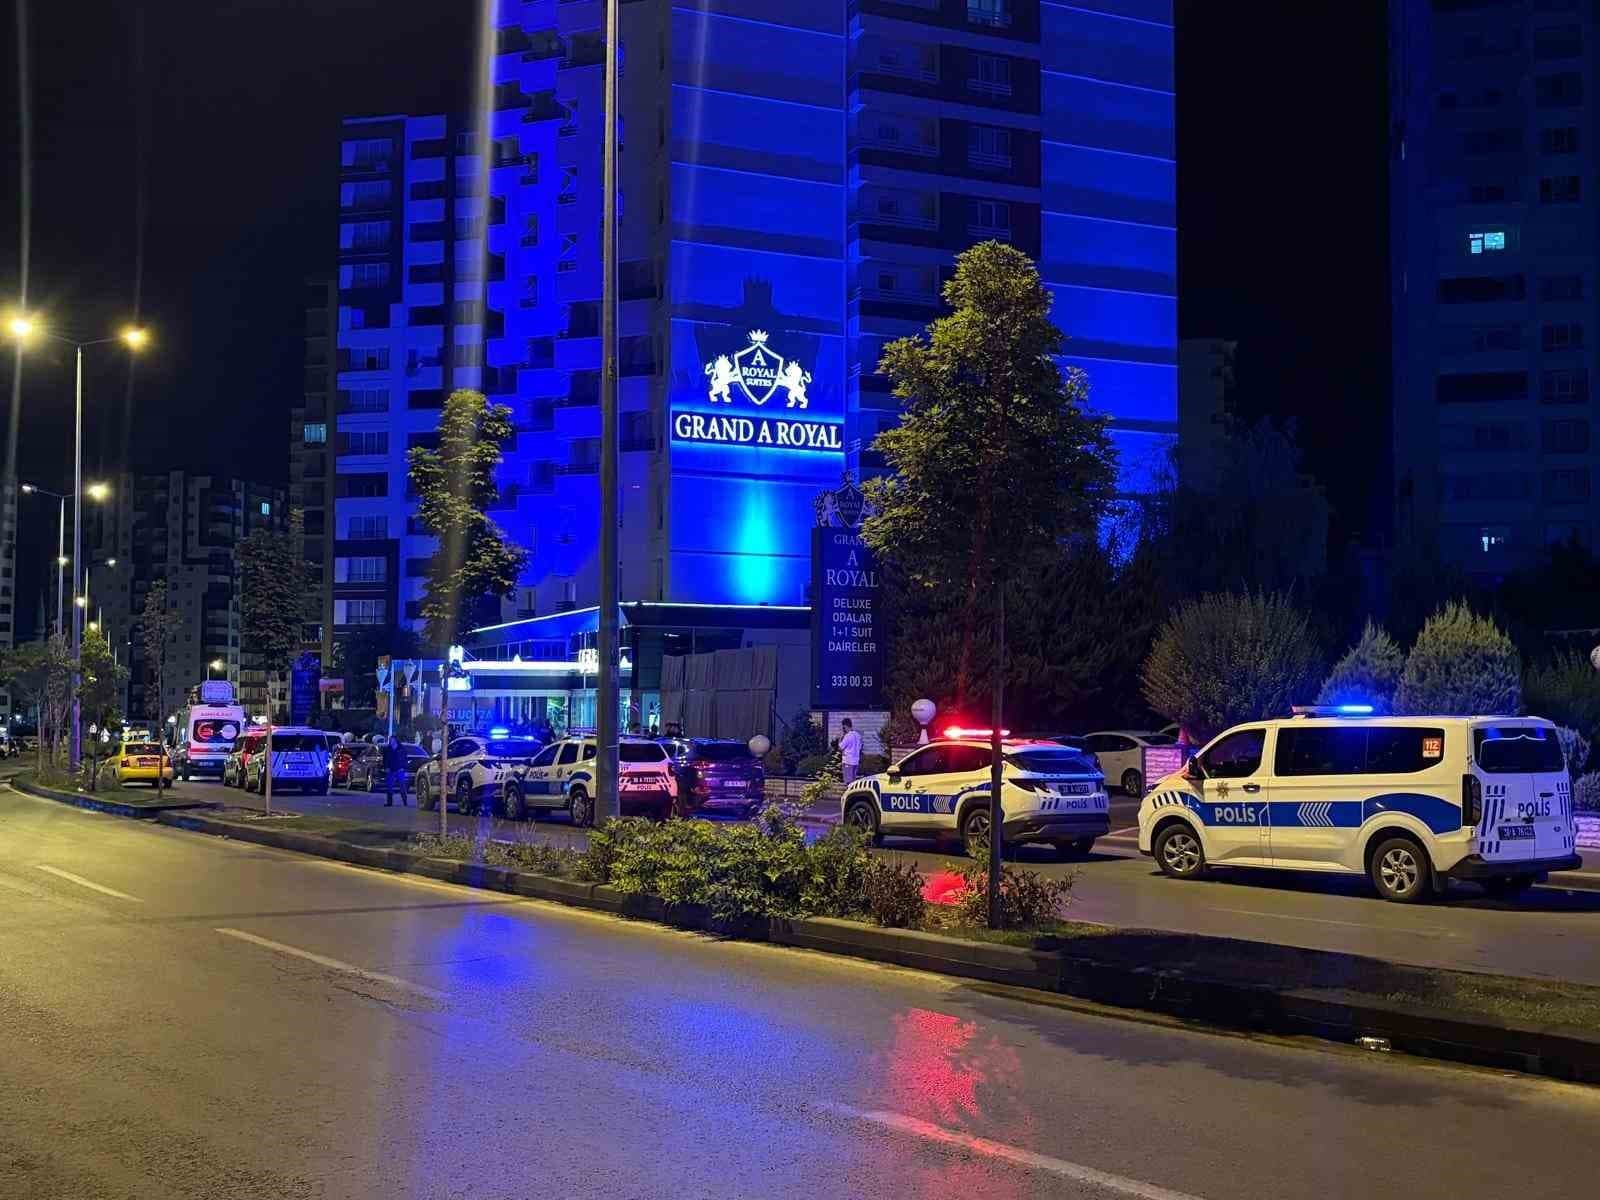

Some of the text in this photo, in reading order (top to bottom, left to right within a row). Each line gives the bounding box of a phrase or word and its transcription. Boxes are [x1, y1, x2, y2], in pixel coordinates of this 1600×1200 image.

[751, 349, 767, 366] A
[742, 367, 777, 378] ROYAL
[675, 414, 842, 448] GRAND A ROYAL
[834, 534, 867, 545] GRAN
[847, 550, 858, 566] A
[826, 569, 879, 587] ROYAL
[834, 598, 872, 609] DELUXE
[832, 612, 872, 623] ODALAR
[832, 627, 873, 638] 1+1 SUIT
[828, 640, 877, 652] DAİRELER
[831, 675, 873, 687] 333 00 33
[1425, 740, 1440, 750] 112
[1214, 803, 1256, 823] POLİS
[1518, 797, 1550, 818] POLİS
